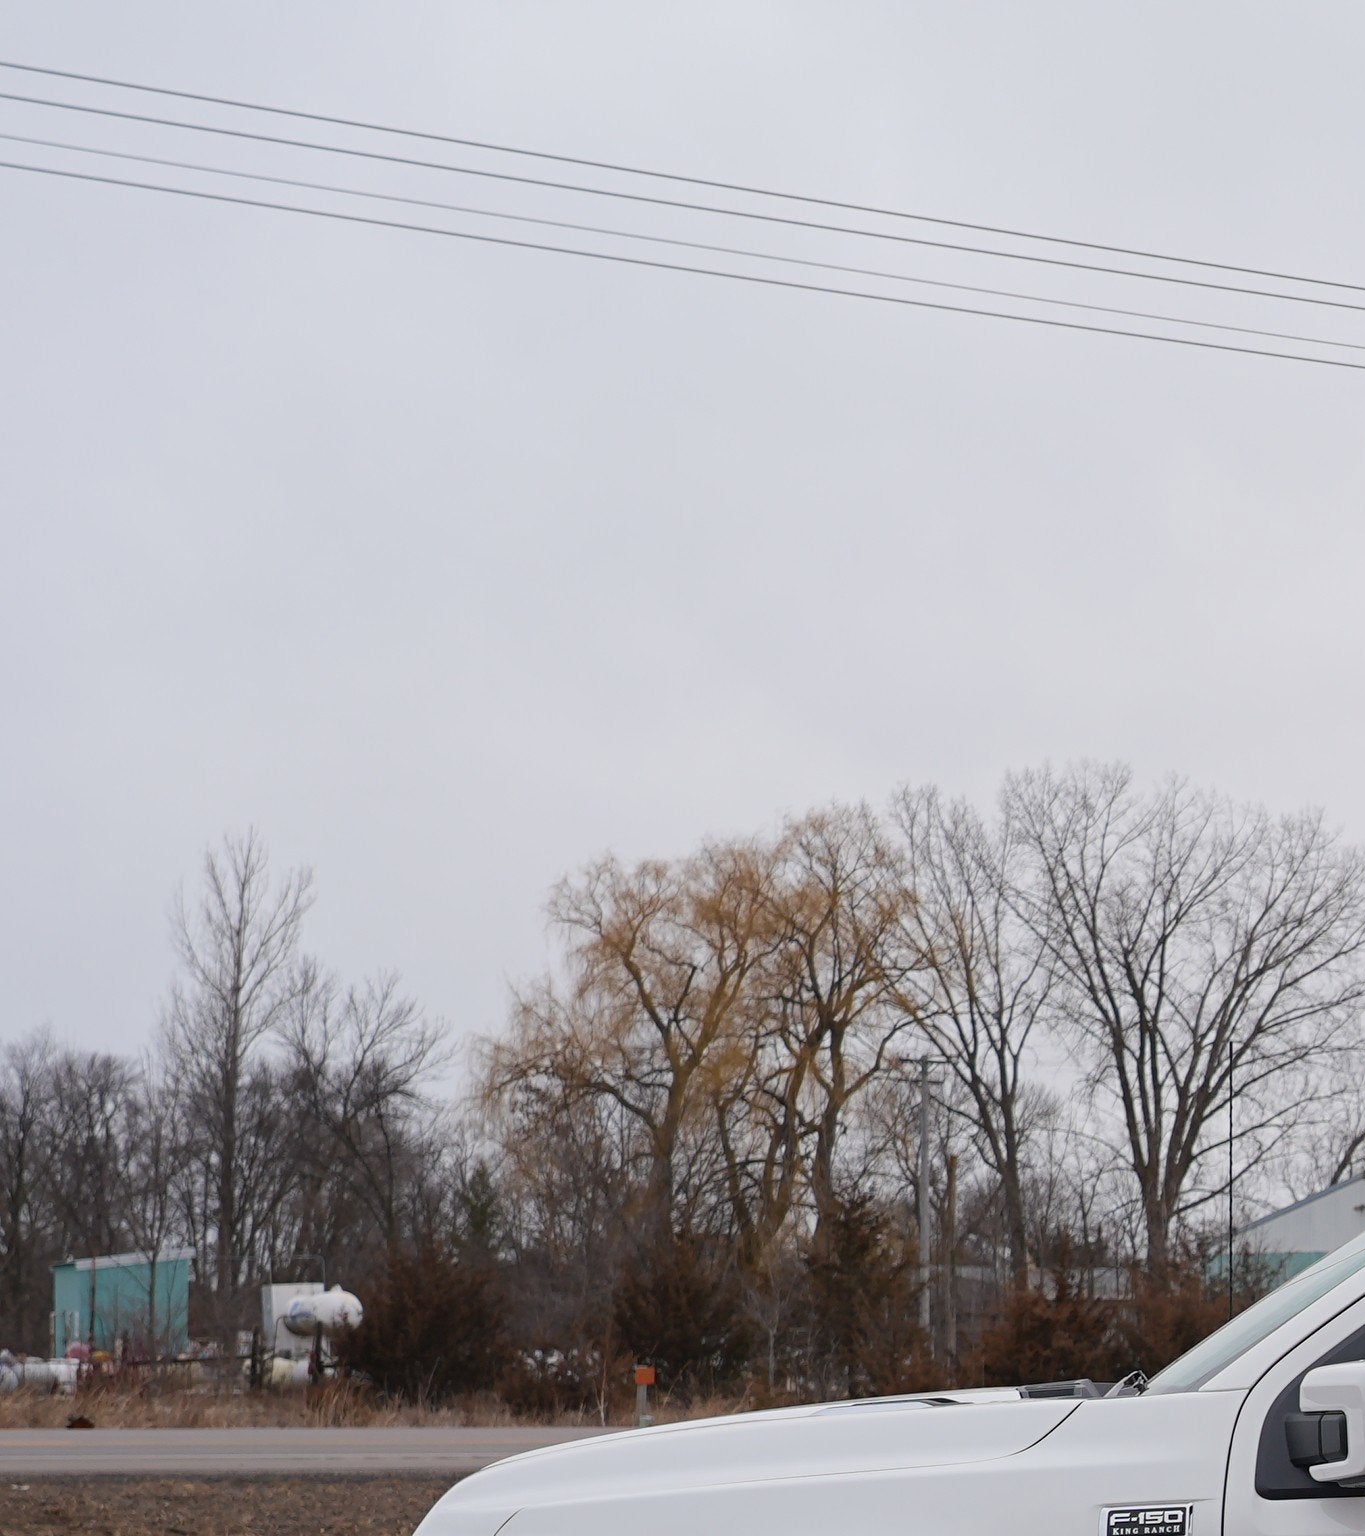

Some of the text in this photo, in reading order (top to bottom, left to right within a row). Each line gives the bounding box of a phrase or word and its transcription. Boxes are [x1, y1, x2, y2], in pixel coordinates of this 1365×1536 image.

[1110, 1511, 1183, 1525] F-150
[1112, 1525, 1181, 1536] KING RANCH
